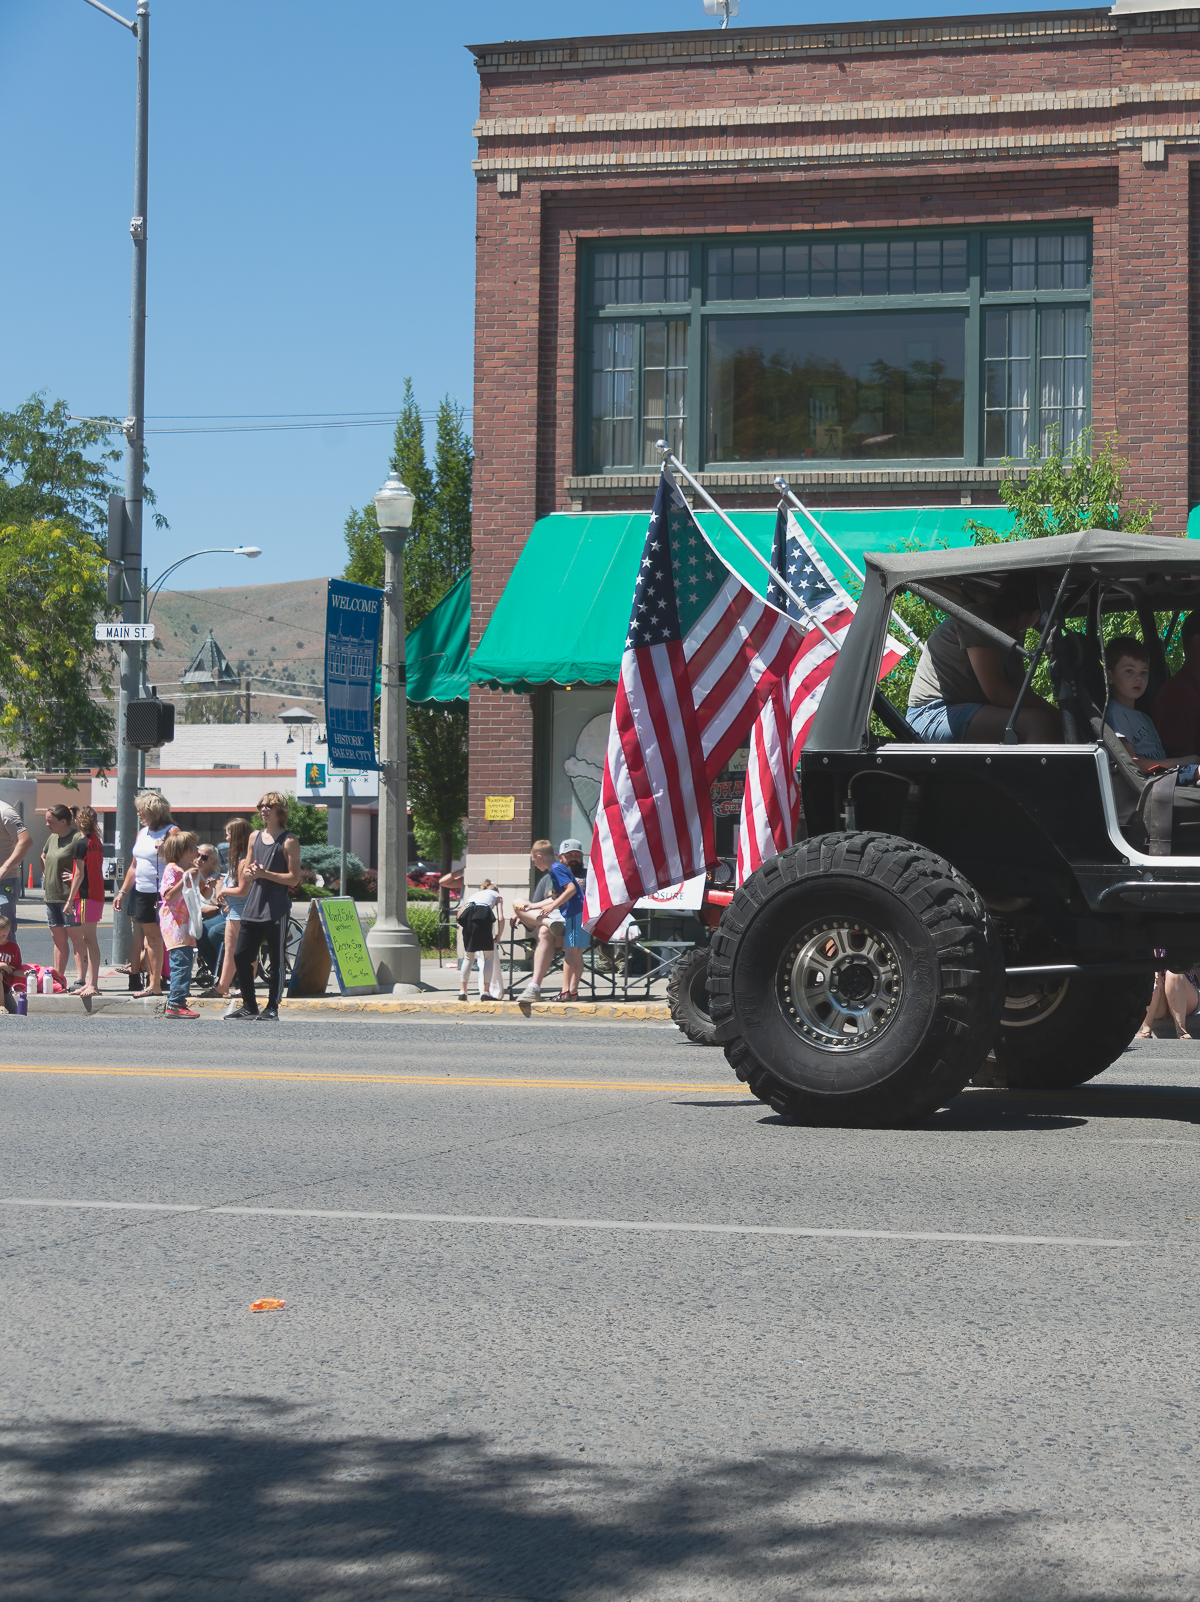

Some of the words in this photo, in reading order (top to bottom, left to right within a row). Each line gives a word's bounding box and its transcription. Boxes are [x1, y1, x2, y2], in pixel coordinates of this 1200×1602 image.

[332, 594, 378, 613] WELCOME
[106, 627, 130, 638] MAIN
[134, 627, 147, 638] ST.
[334, 733, 364, 747] HISTORIC
[331, 747, 356, 760] BAKER
[356, 750, 371, 761] CITY
